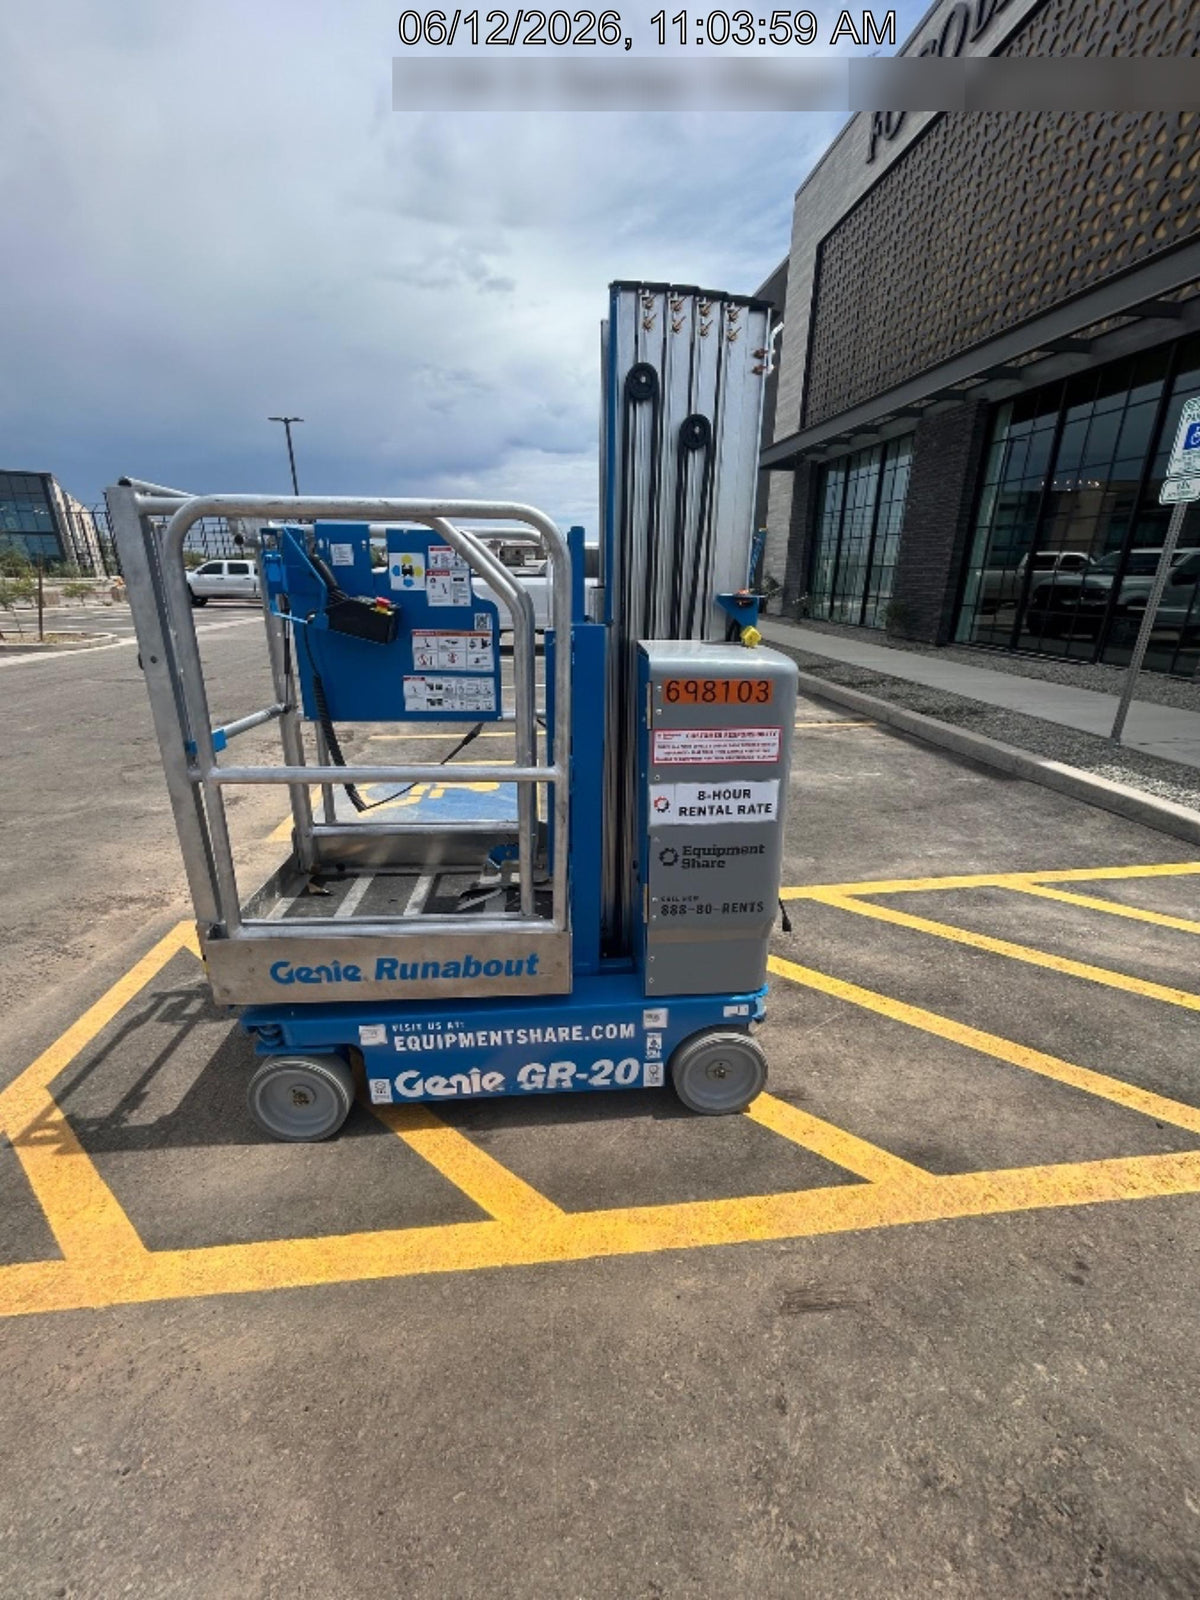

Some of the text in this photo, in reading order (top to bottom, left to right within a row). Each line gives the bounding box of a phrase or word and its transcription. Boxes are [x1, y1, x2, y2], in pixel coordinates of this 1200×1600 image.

[666, 680, 769, 703] 698103
[697, 788, 751, 801] 8-HOUR
[678, 803, 773, 817] RENTAL RATE
[681, 843, 766, 859] Equipment
[681, 858, 726, 869] Share
[269, 952, 539, 984] Genie Runabout
[427, 1021, 442, 1031] US
[393, 1023, 636, 1052] EQUIPMENTSHARE.COM
[394, 1057, 640, 1099] Genie GR-20
